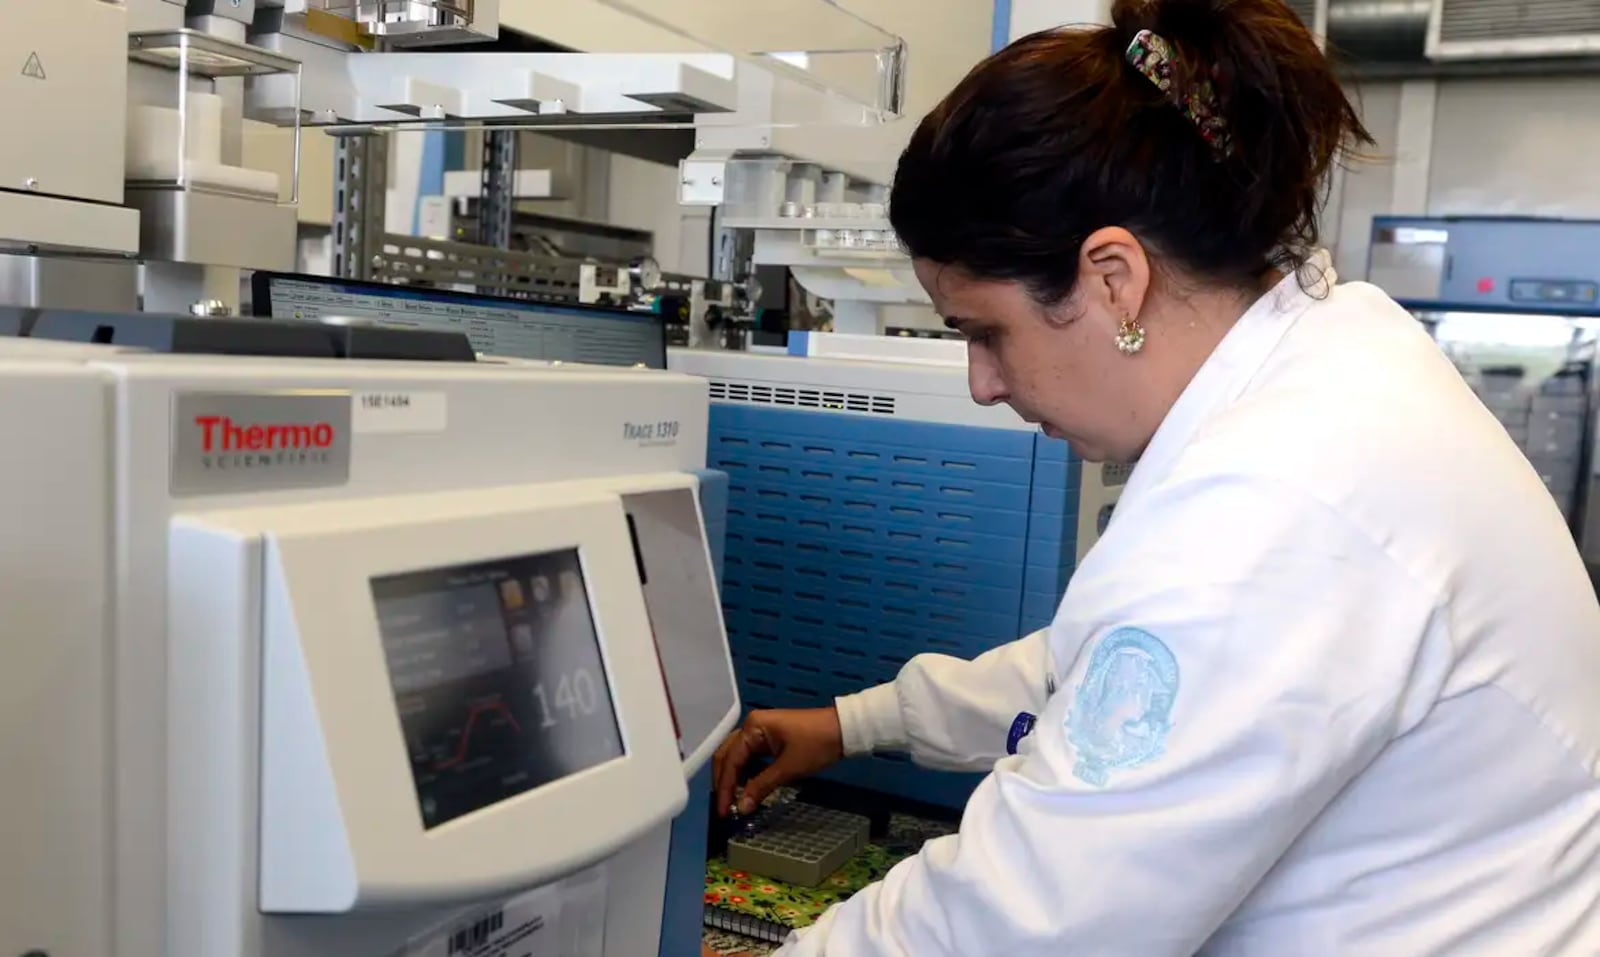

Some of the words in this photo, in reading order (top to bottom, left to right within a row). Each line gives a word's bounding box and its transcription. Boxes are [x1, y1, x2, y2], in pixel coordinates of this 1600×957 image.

[195, 415, 335, 452] Thermo
[656, 420, 679, 439] 1310
[201, 452, 328, 469] SCIENTIFIC
[532, 667, 596, 728] 140
